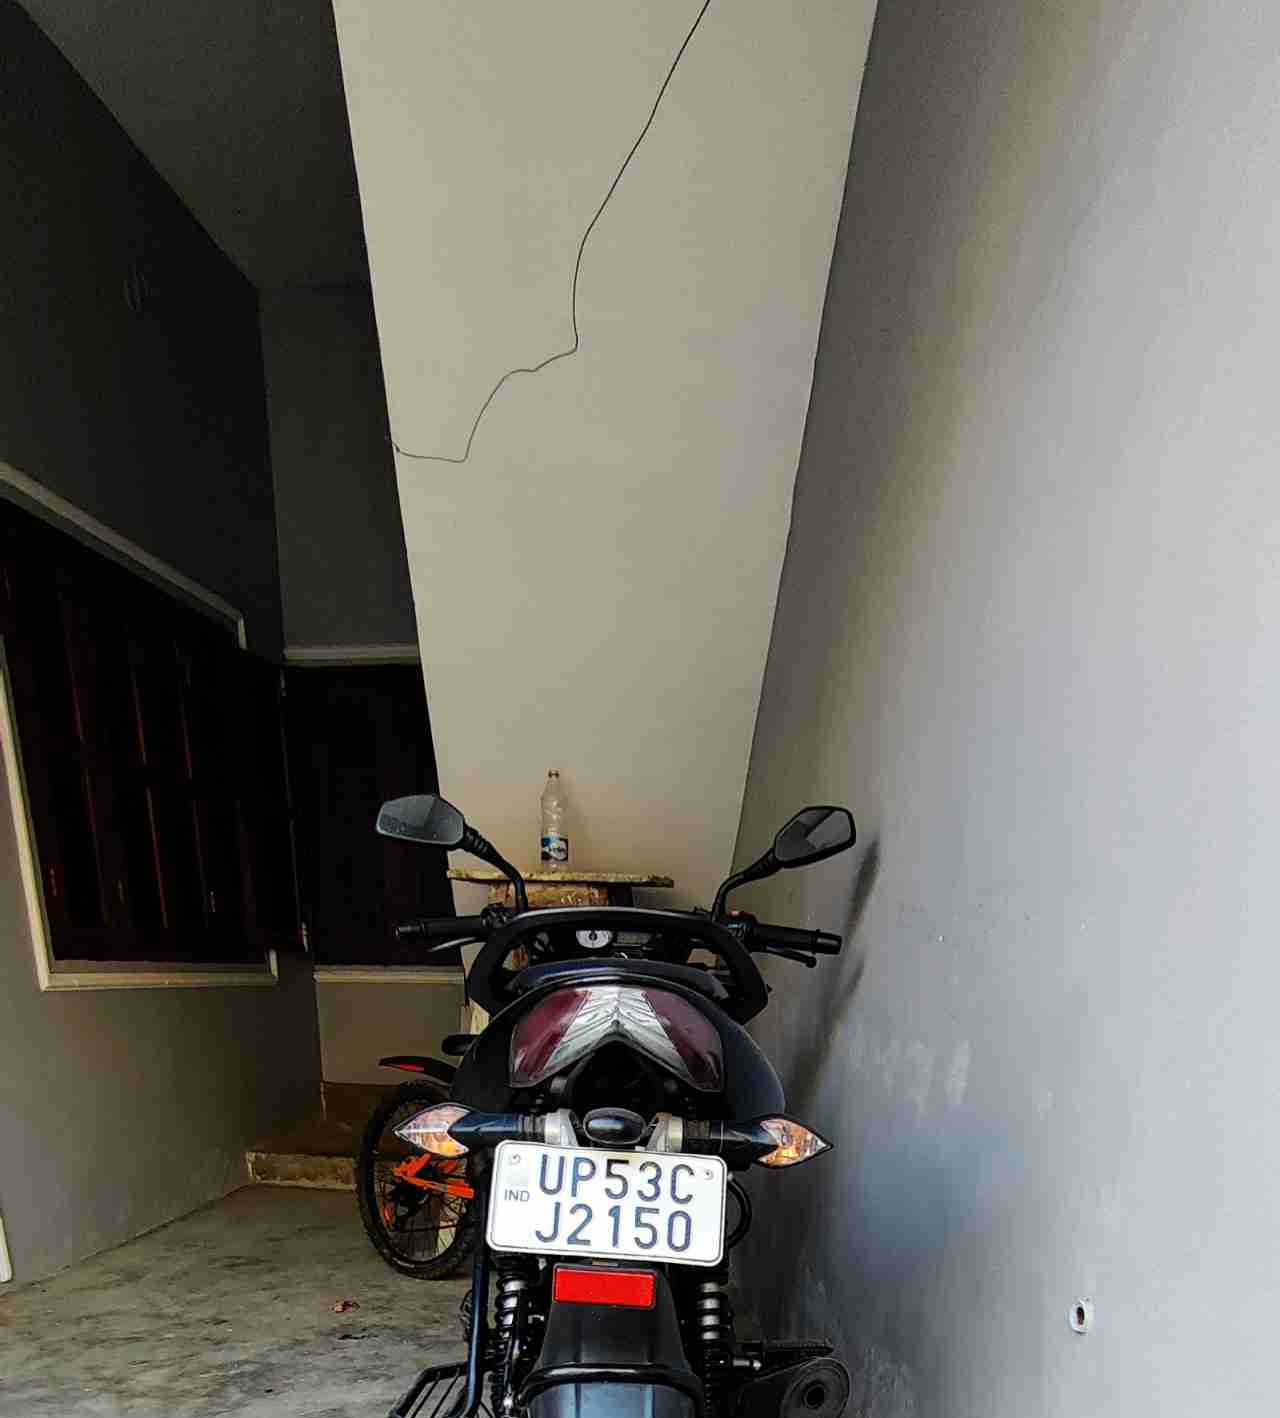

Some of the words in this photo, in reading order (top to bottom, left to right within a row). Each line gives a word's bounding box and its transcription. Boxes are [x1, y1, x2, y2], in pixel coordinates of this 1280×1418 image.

[504, 1189, 530, 1202] IND
[538, 1154, 694, 1204] UP53C
[535, 1202, 692, 1252] J2150
